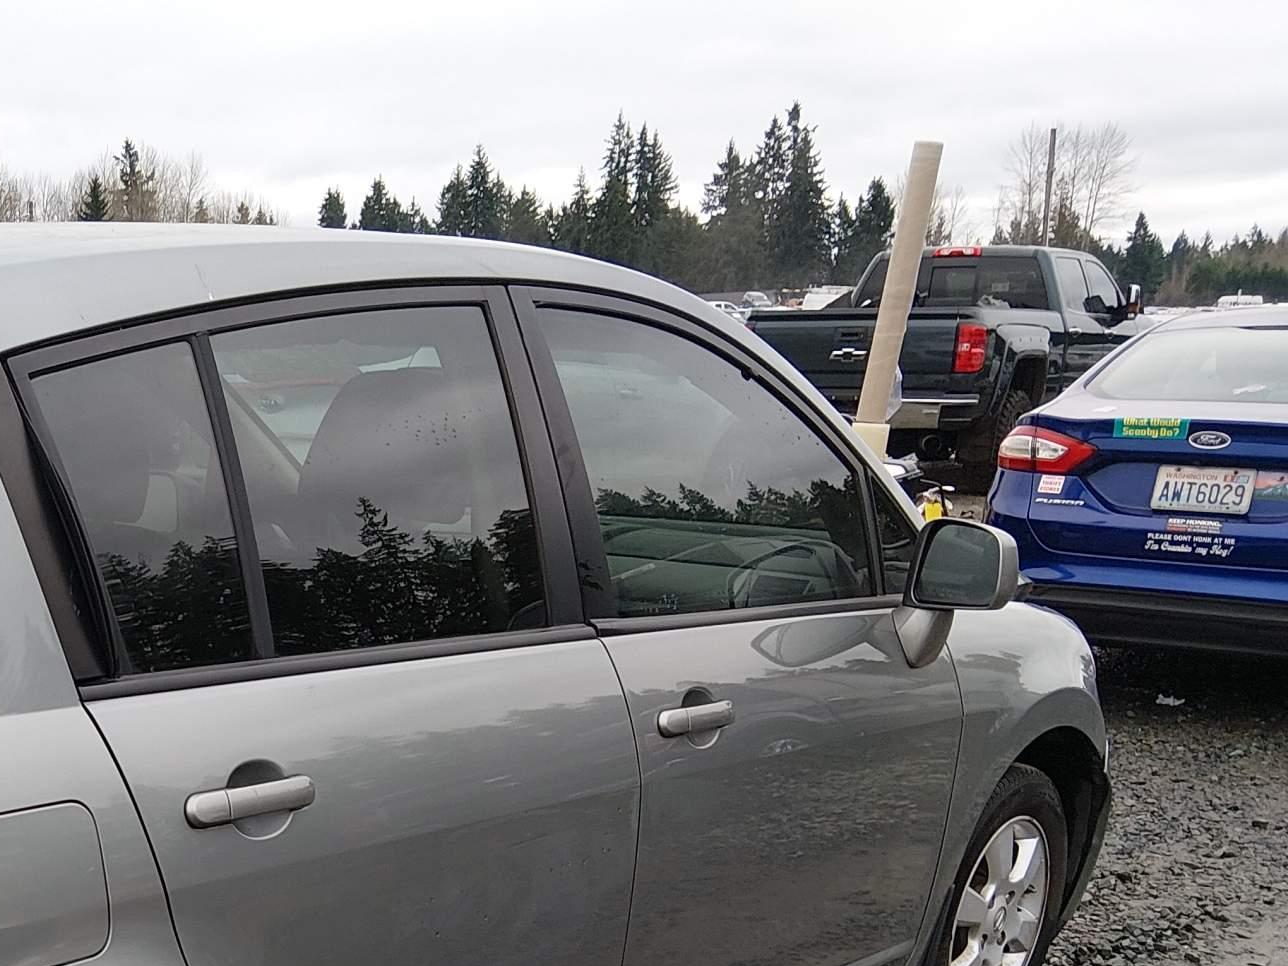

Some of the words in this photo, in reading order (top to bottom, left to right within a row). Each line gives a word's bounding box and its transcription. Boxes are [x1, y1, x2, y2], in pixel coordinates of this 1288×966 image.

[1123, 416, 1148, 427] What
[1150, 417, 1181, 427] Would
[1122, 427, 1159, 438] Scooby
[1159, 428, 1180, 437] Do?
[1166, 472, 1218, 481] WASHINGTON
[1158, 481, 1246, 506] AWT6029
[1147, 533, 1172, 541] PLEASE
[1173, 534, 1192, 542] DONT
[1193, 536, 1212, 544] HONK
[1224, 538, 1236, 546] ME
